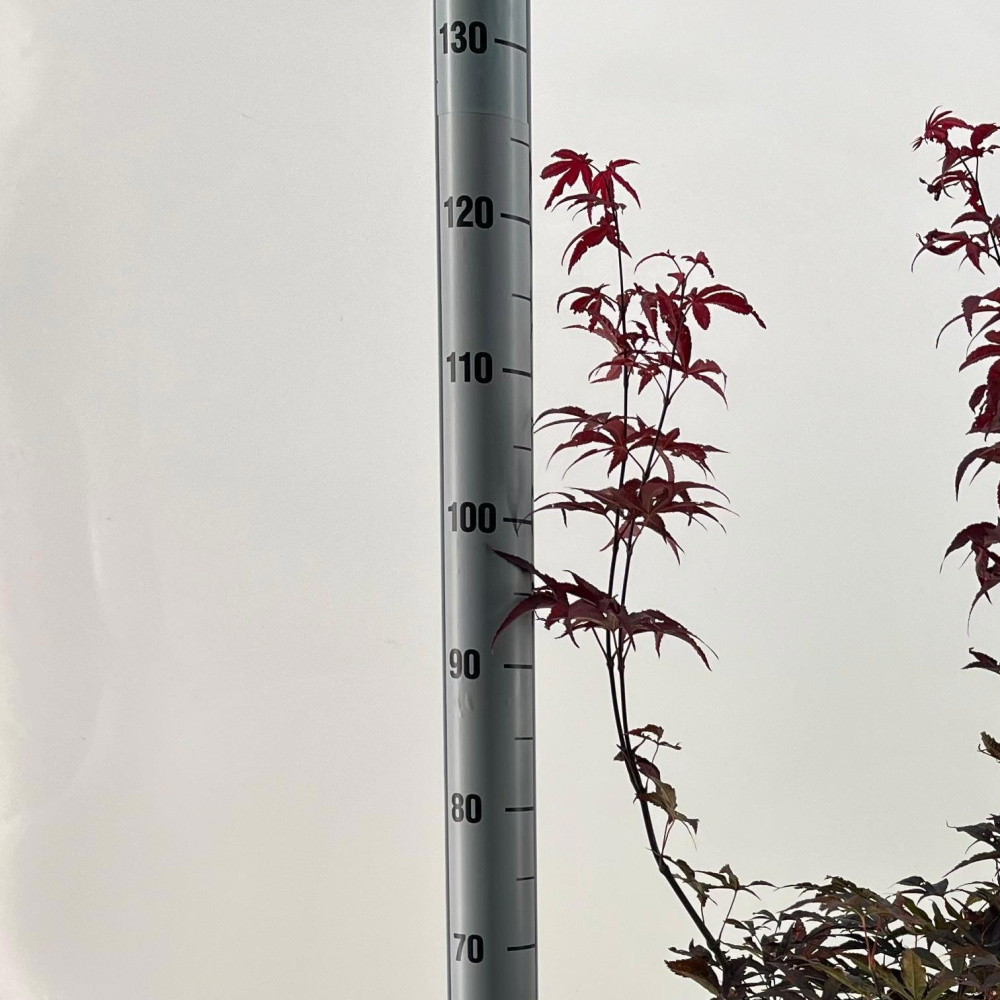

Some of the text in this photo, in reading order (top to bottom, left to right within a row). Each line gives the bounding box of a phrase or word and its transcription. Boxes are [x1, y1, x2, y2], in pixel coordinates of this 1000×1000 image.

[439, 20, 487, 54] 130
[443, 195, 493, 229] 120
[446, 352, 493, 384] 110
[448, 502, 496, 534] 100
[450, 648, 481, 679] 90
[452, 792, 482, 824] 80
[454, 932, 484, 963] 70
